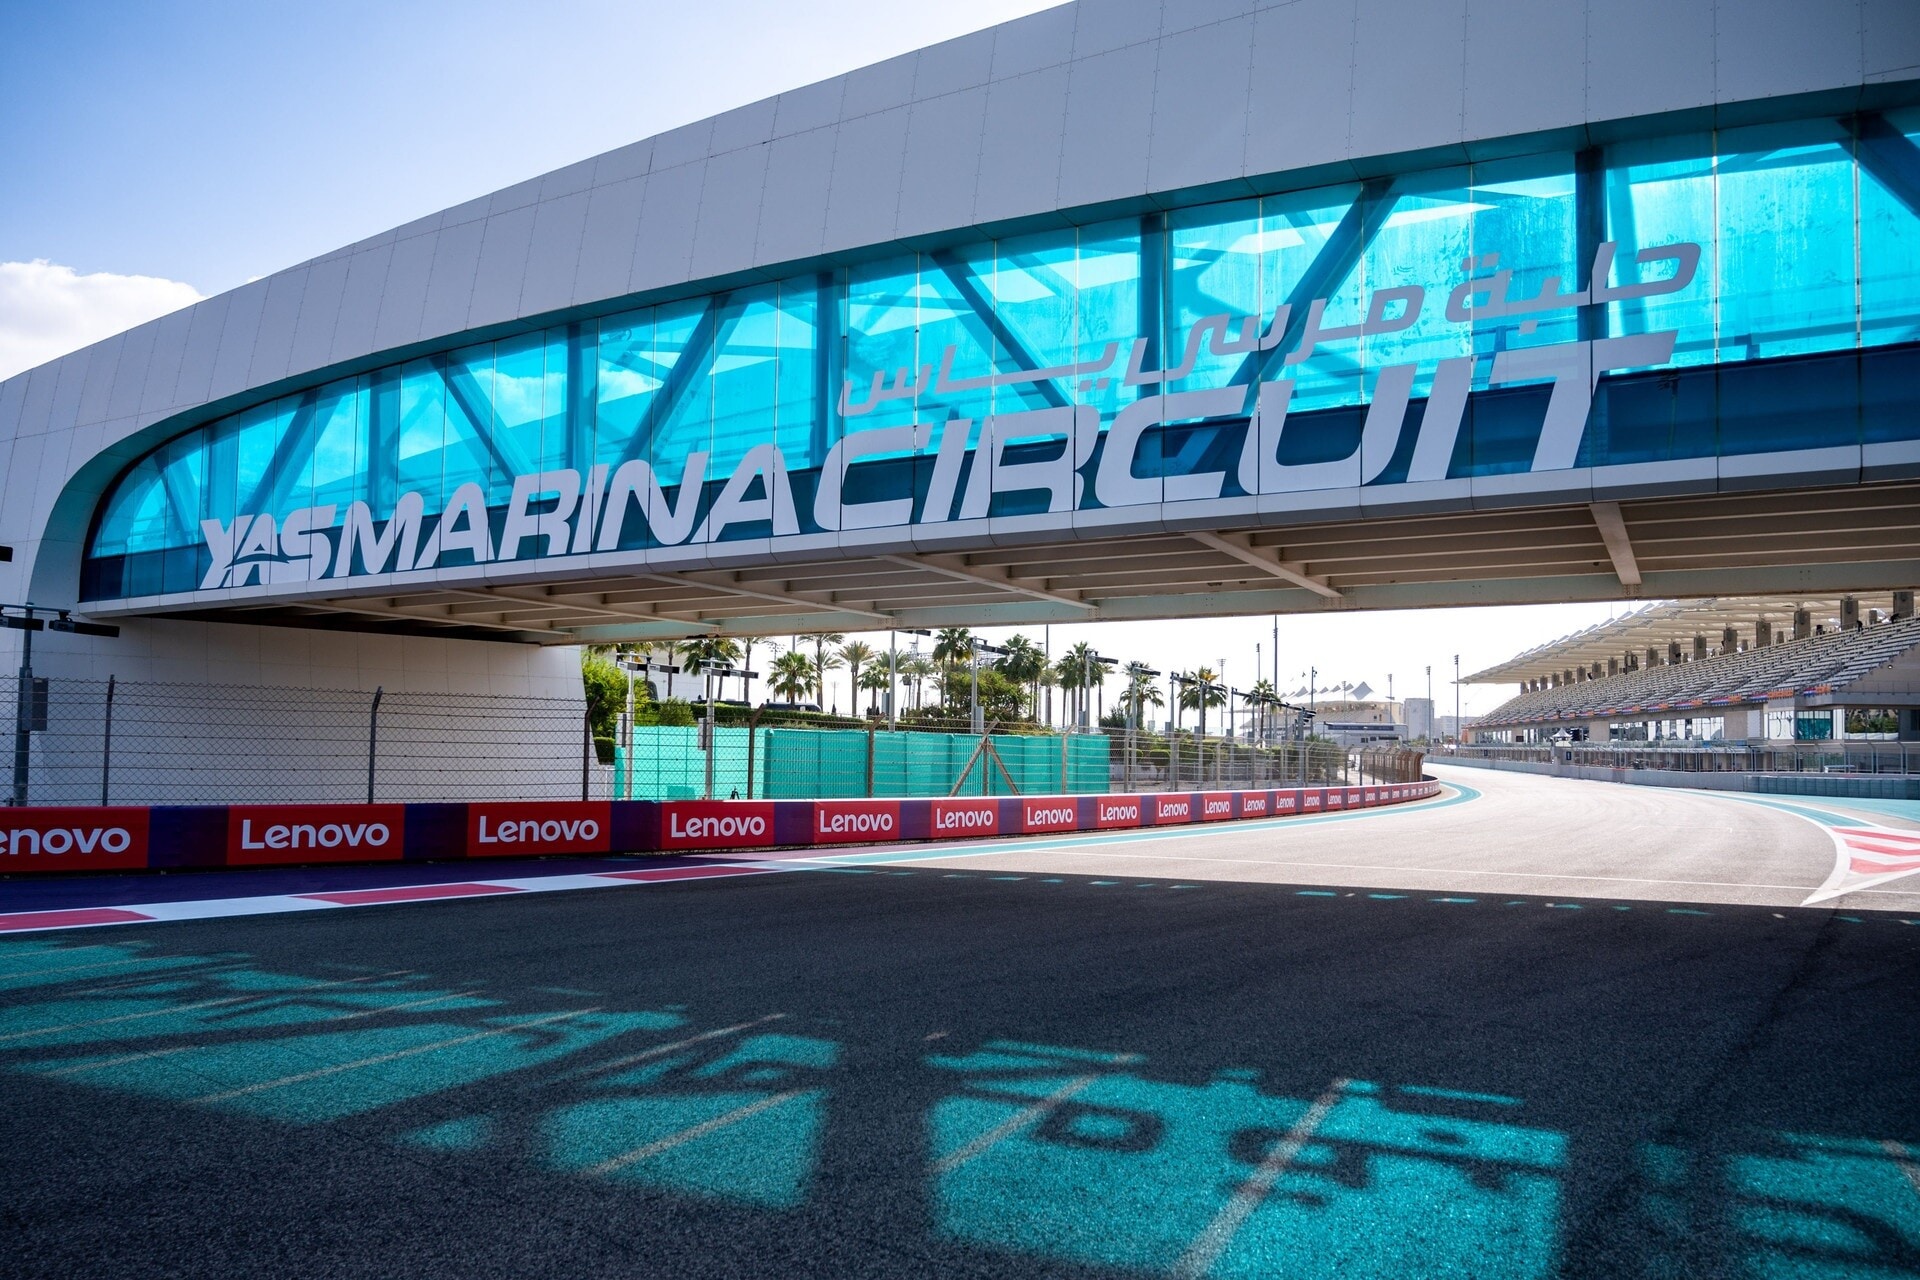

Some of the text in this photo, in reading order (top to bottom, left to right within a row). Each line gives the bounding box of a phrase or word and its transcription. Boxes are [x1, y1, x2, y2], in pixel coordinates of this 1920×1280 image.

[1445, 241, 1701, 335] حلبة
[837, 341, 1120, 417] ياس
[813, 329, 1679, 532] CIRCUIT
[1100, 803, 1138, 821] Lenovo
[1158, 801, 1189, 818] Lenovo
[1204, 799, 1230, 814] Lenovo
[1243, 797, 1266, 812] Lenovo
[1276, 795, 1295, 809] Lenovo
[671, 812, 766, 838] Lenovo
[819, 809, 893, 833] Lenovo
[936, 807, 994, 829] Lenovo
[1028, 806, 1073, 826] Lenovo
[0, 827, 131, 855] novo
[242, 819, 390, 850] Lenovo
[478, 815, 599, 843] Lenovo
